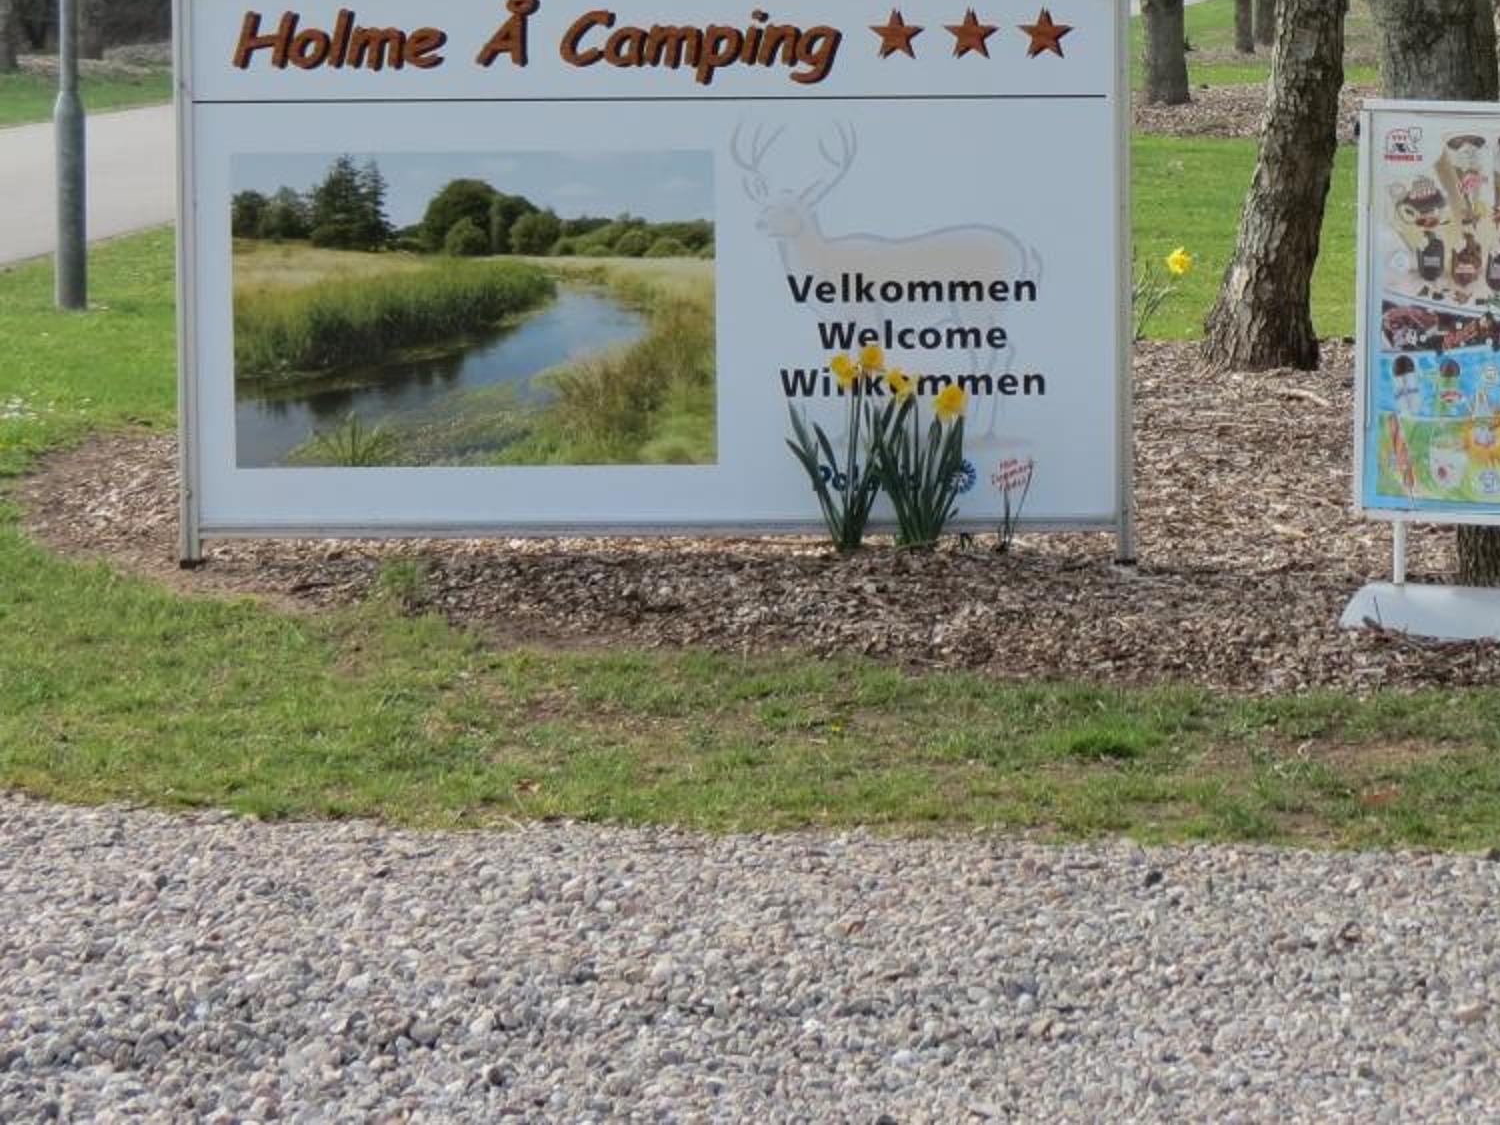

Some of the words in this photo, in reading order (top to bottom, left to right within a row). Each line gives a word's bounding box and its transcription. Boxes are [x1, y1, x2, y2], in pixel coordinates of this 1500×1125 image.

[233, 9, 447, 72] Holme
[559, 9, 843, 86] Camping
[787, 272, 1037, 304] Velkommen
[818, 319, 1008, 350] Welcome
